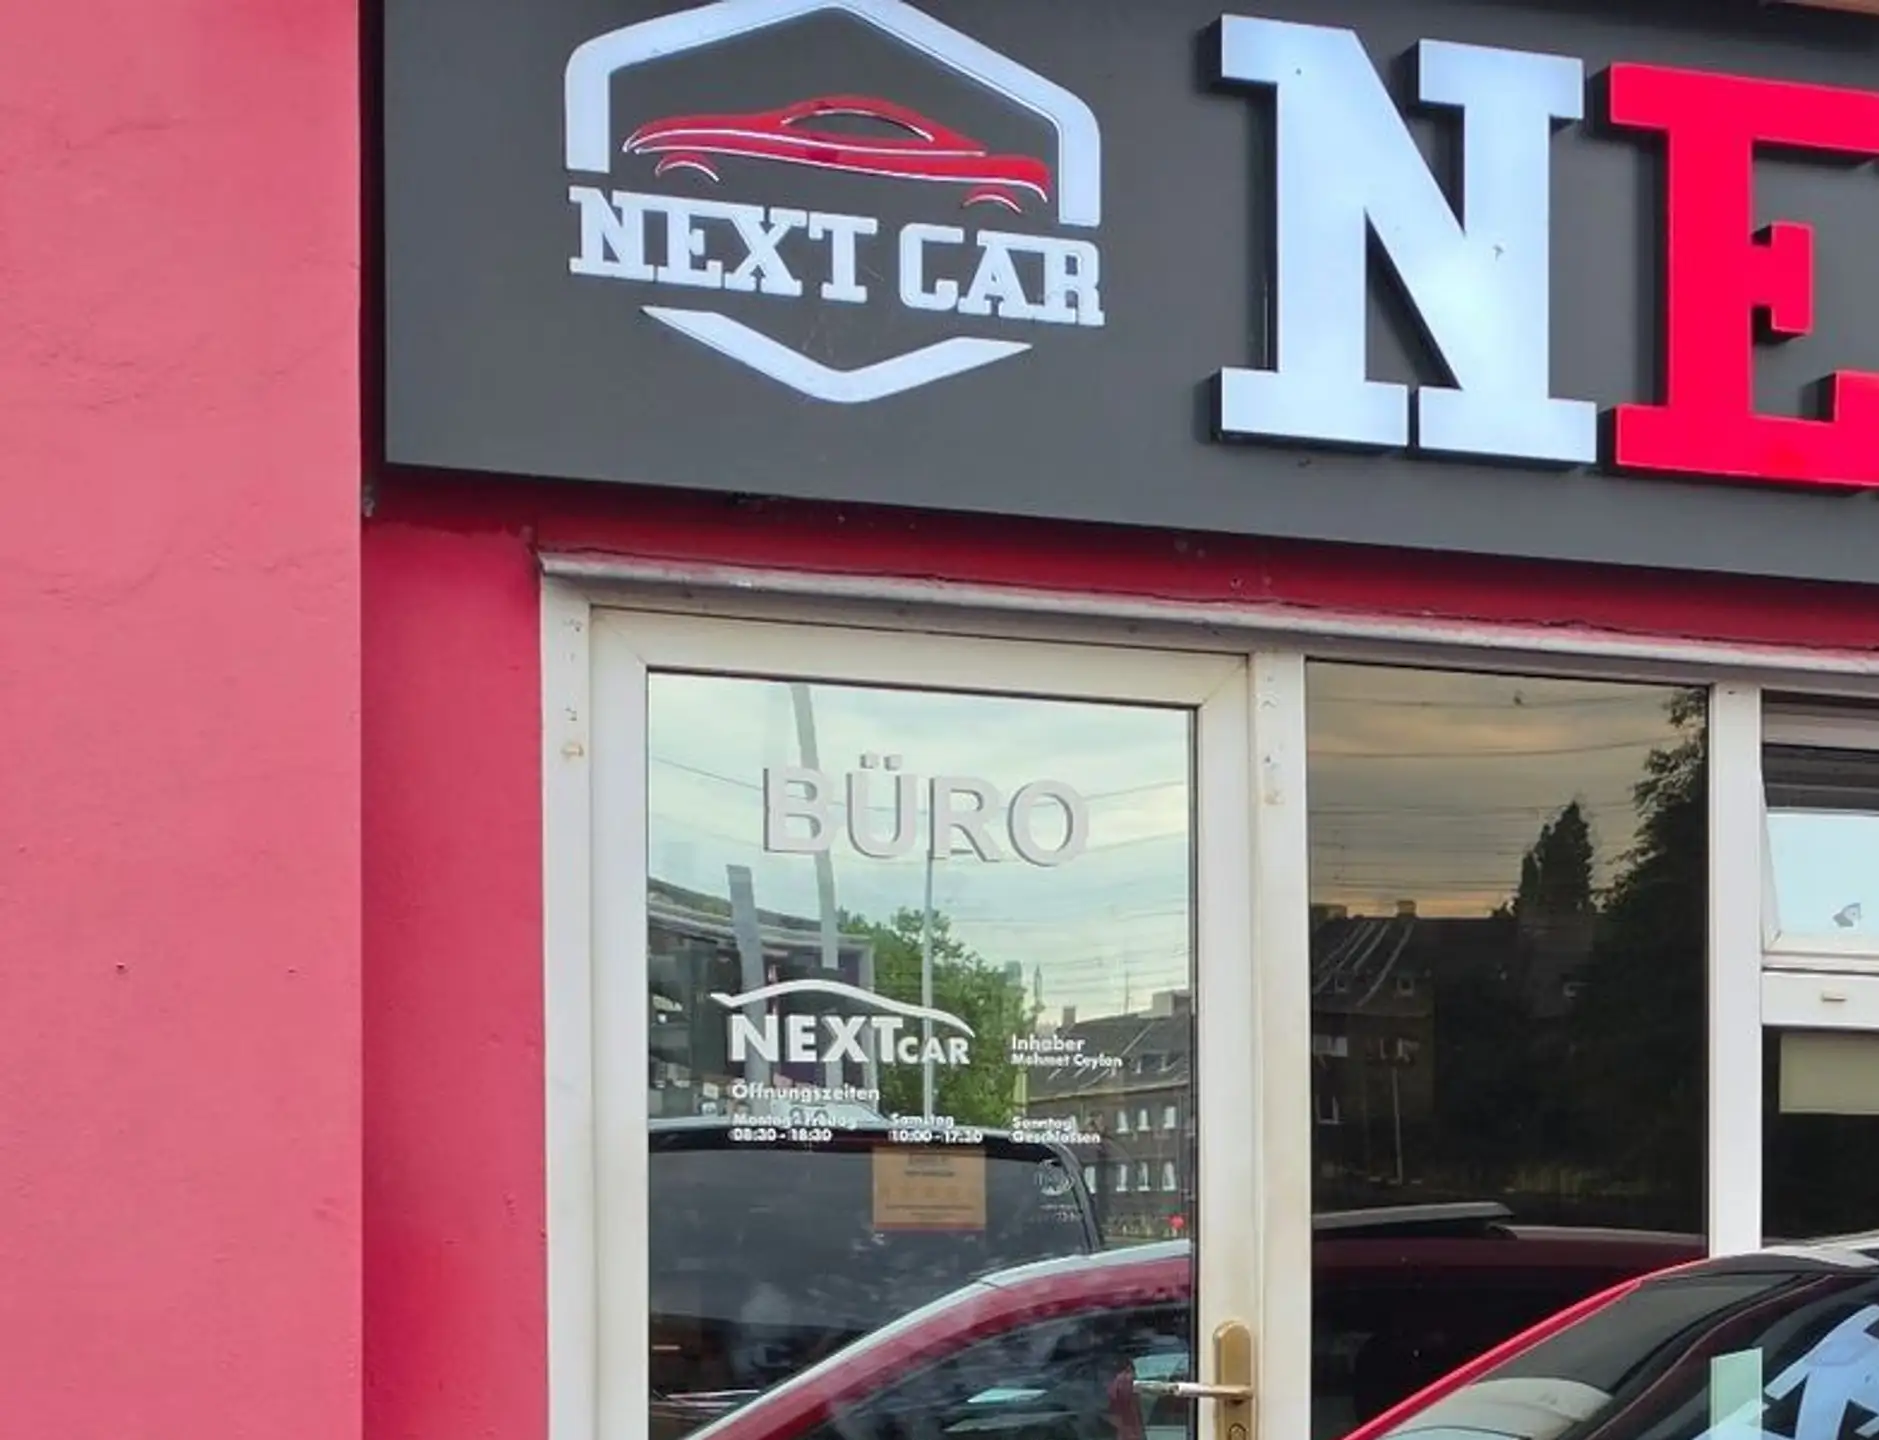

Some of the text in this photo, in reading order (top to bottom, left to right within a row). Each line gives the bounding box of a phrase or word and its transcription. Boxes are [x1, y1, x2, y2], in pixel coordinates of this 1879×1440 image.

[569, 186, 1105, 325] NEXT CAR
[763, 753, 1090, 867] BÜRO
[1012, 1033, 1085, 1050] Inhaber
